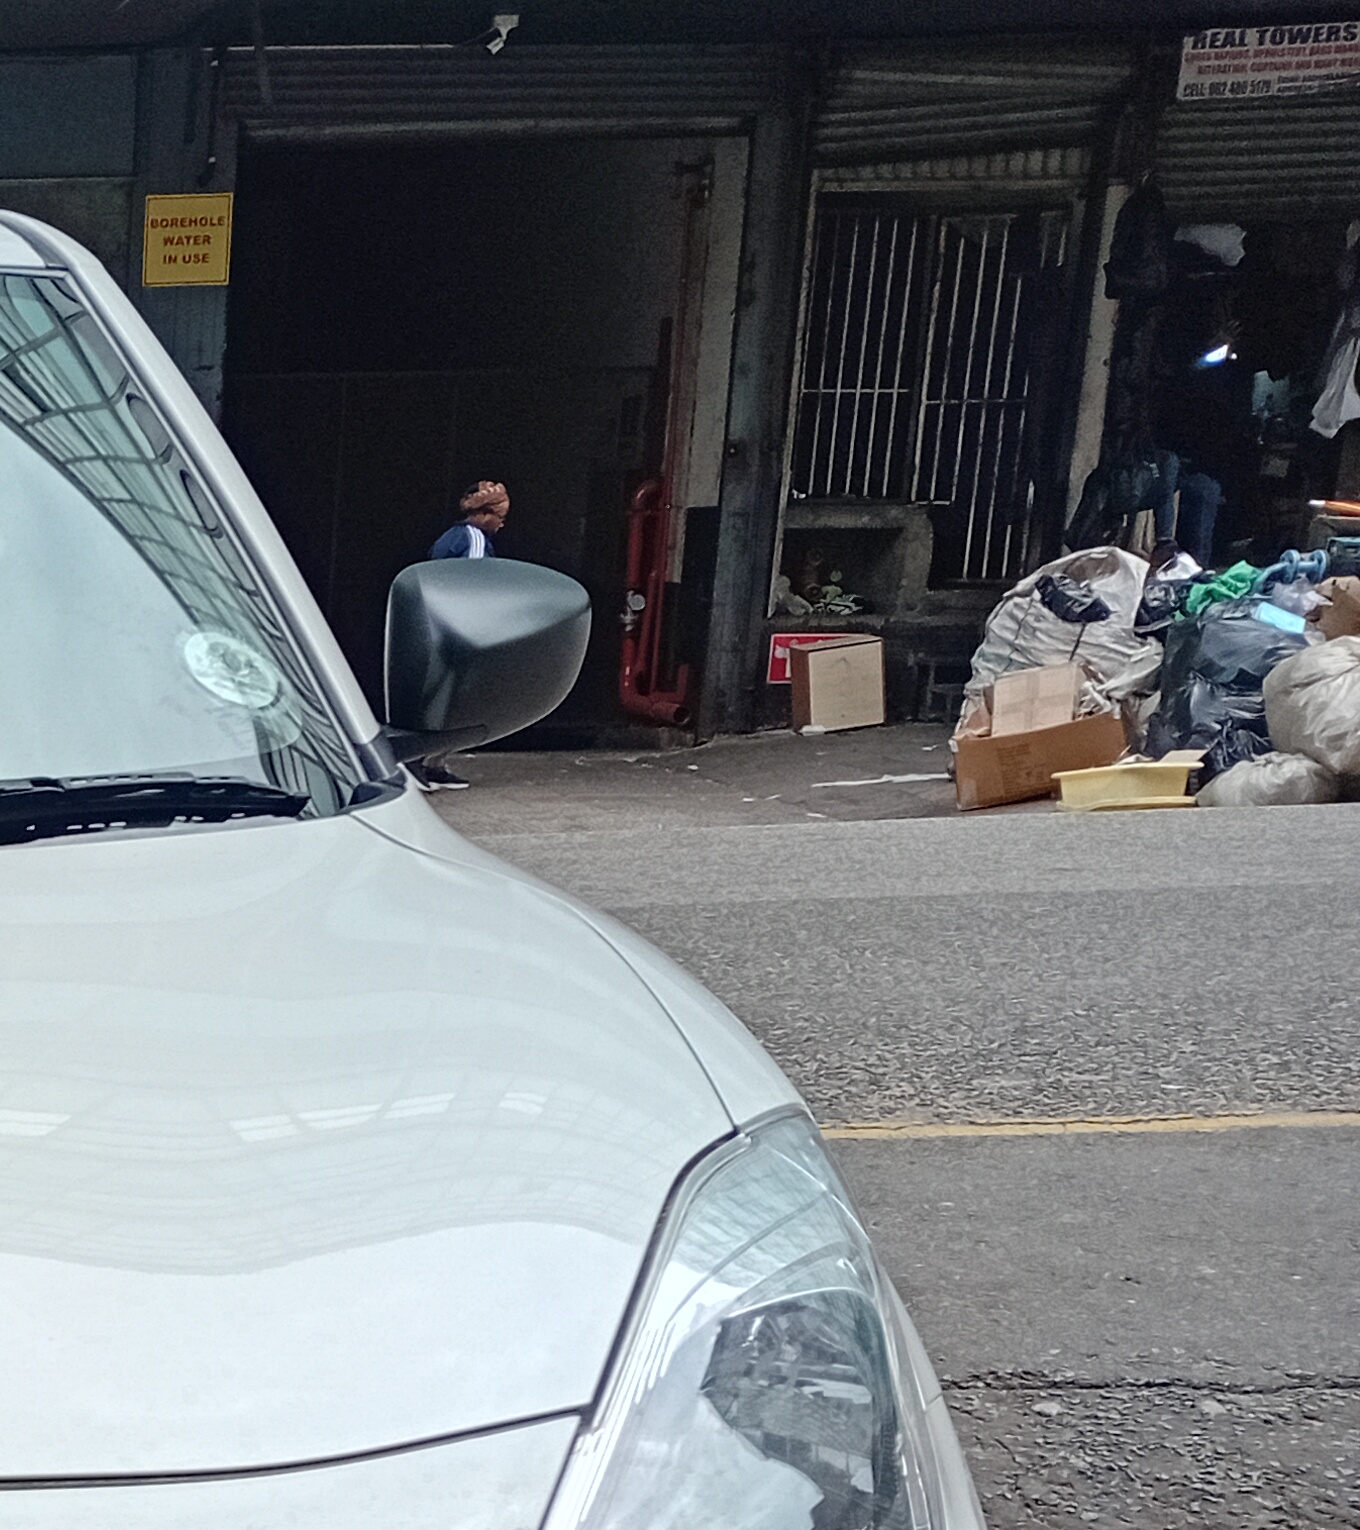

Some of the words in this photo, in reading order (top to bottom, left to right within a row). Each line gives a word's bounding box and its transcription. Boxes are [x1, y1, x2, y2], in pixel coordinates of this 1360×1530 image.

[1191, 29, 1248, 50] REAL
[1255, 23, 1359, 47] TOWERS
[149, 215, 226, 229] BOREHOLE
[162, 235, 212, 247] WATER
[162, 254, 178, 264] IN
[182, 252, 210, 265] USE
